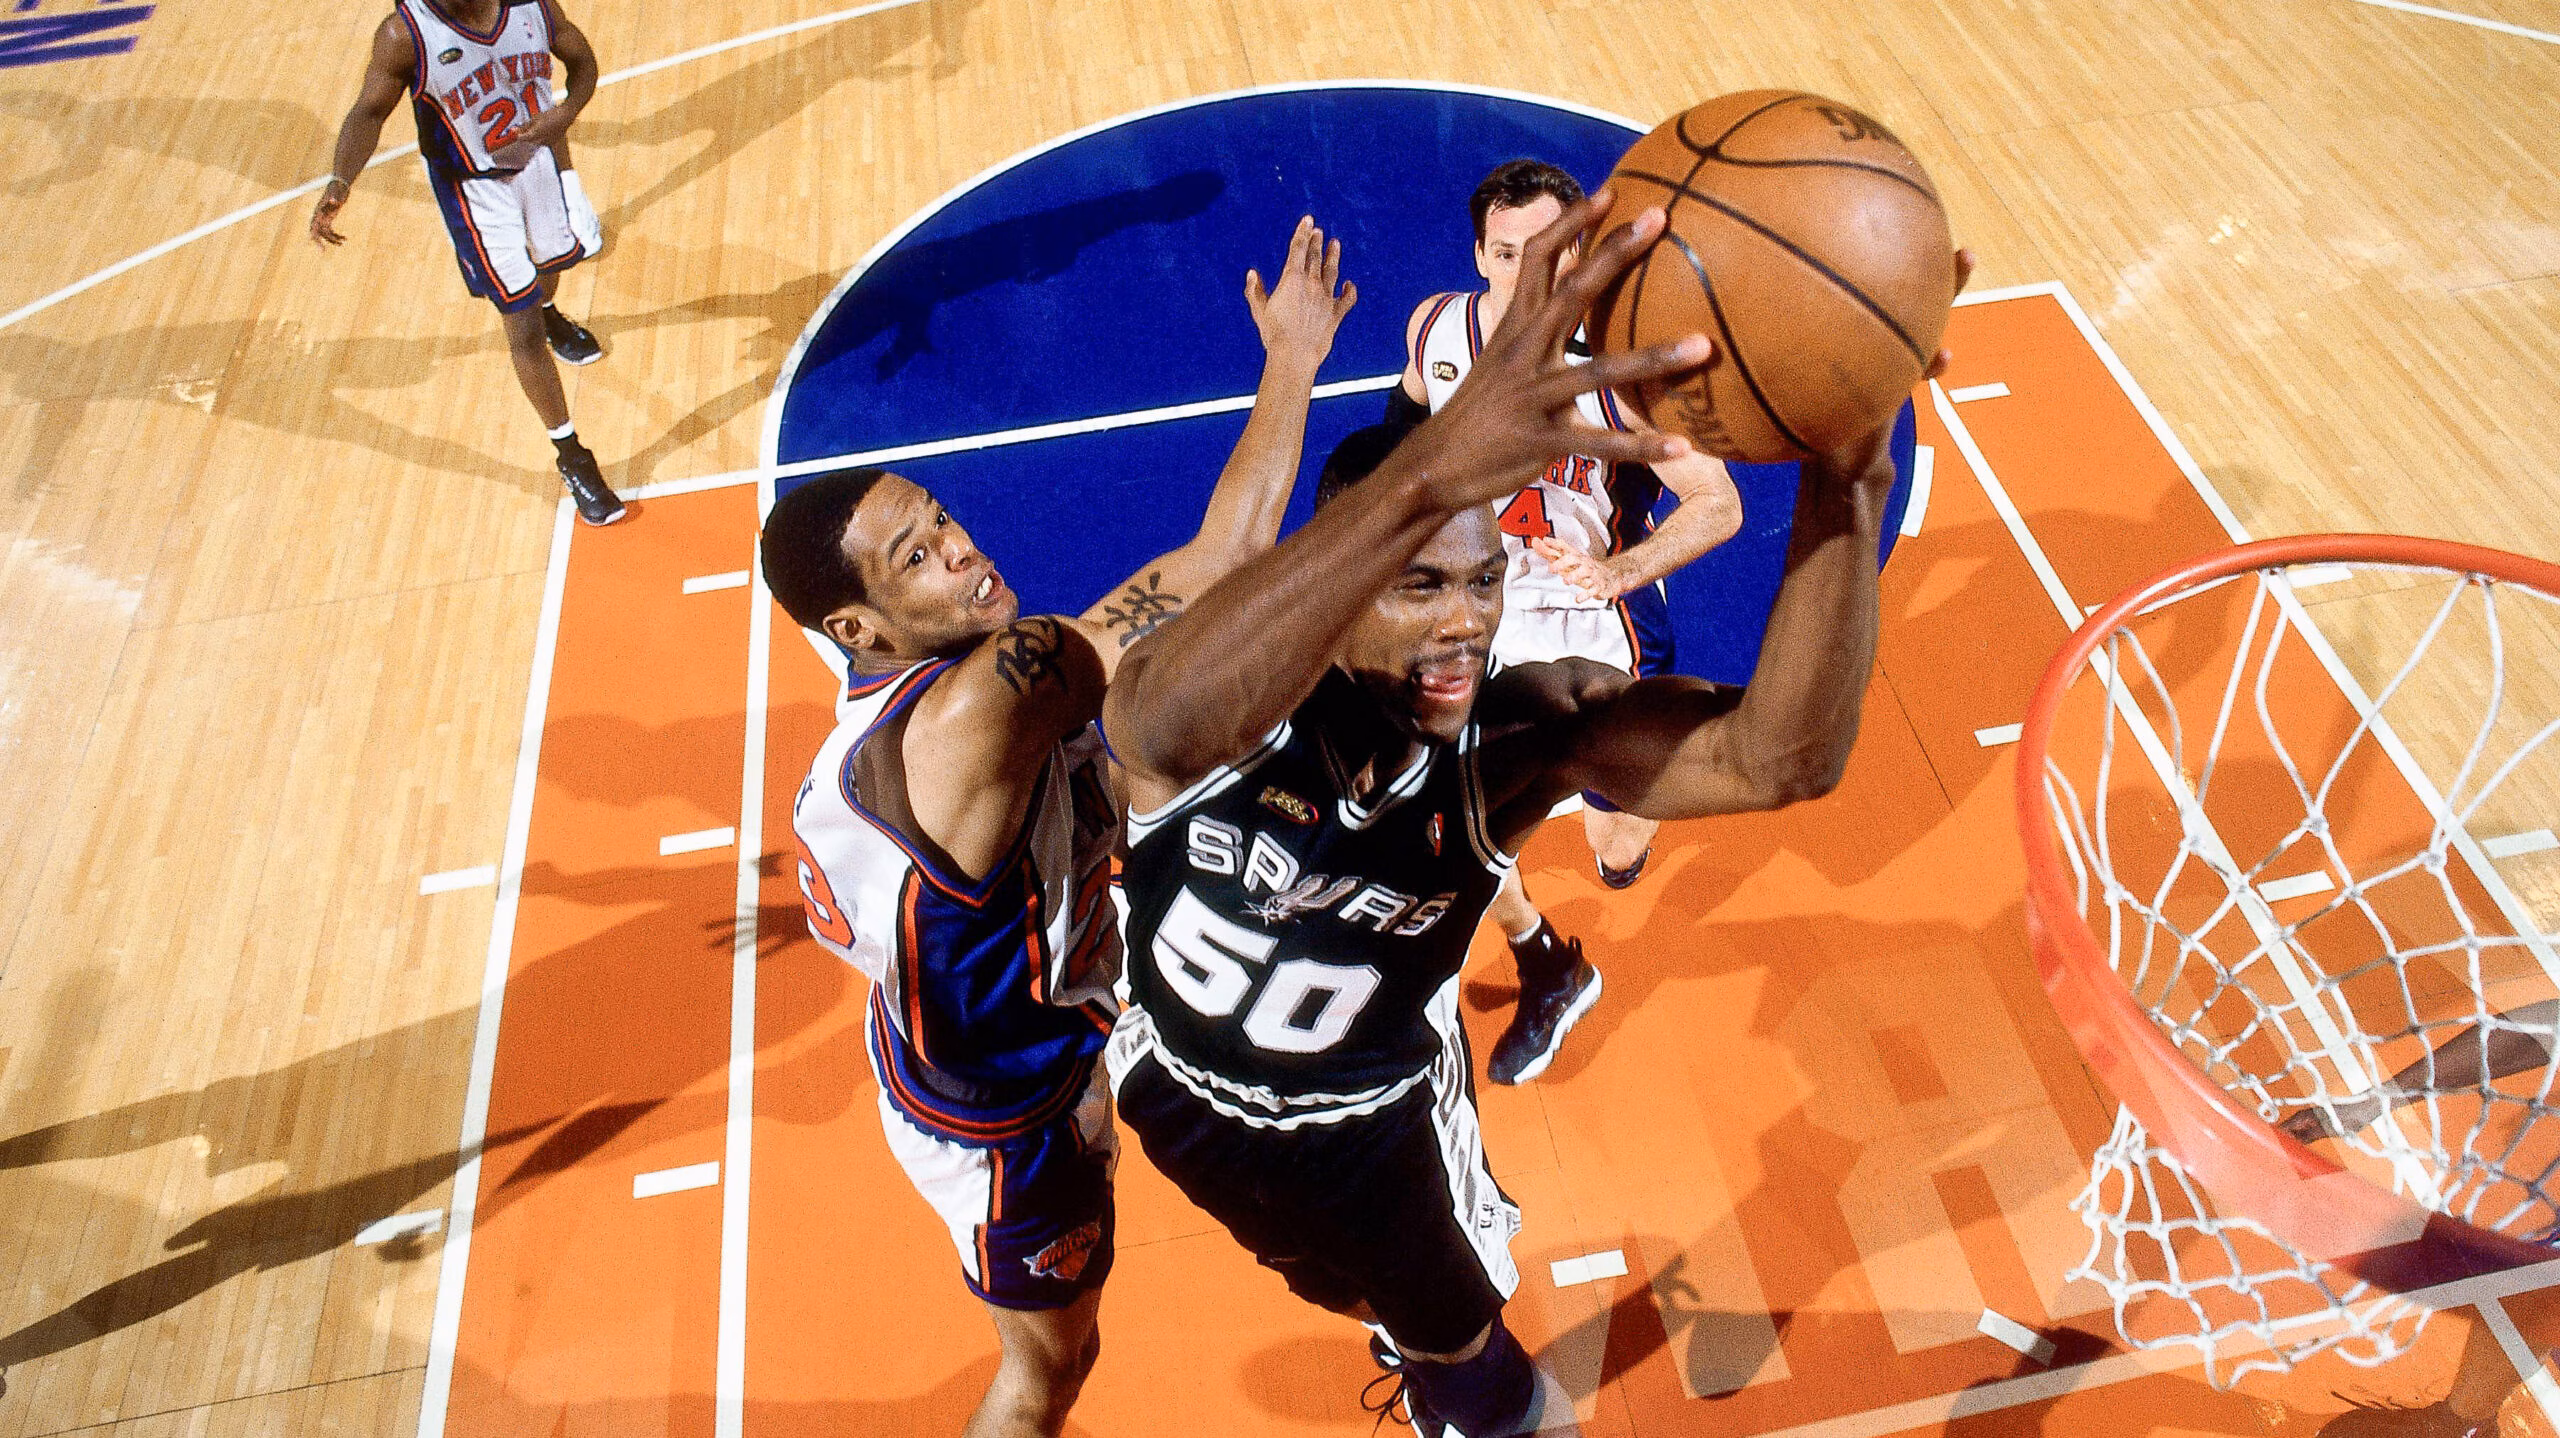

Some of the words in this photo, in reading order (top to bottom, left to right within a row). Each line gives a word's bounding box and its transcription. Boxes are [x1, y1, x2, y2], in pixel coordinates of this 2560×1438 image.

[441, 60, 495, 119] NEW
[478, 81, 541, 153] 21
[1187, 814, 1458, 936] SPURS
[1151, 884, 1383, 1055] 50
